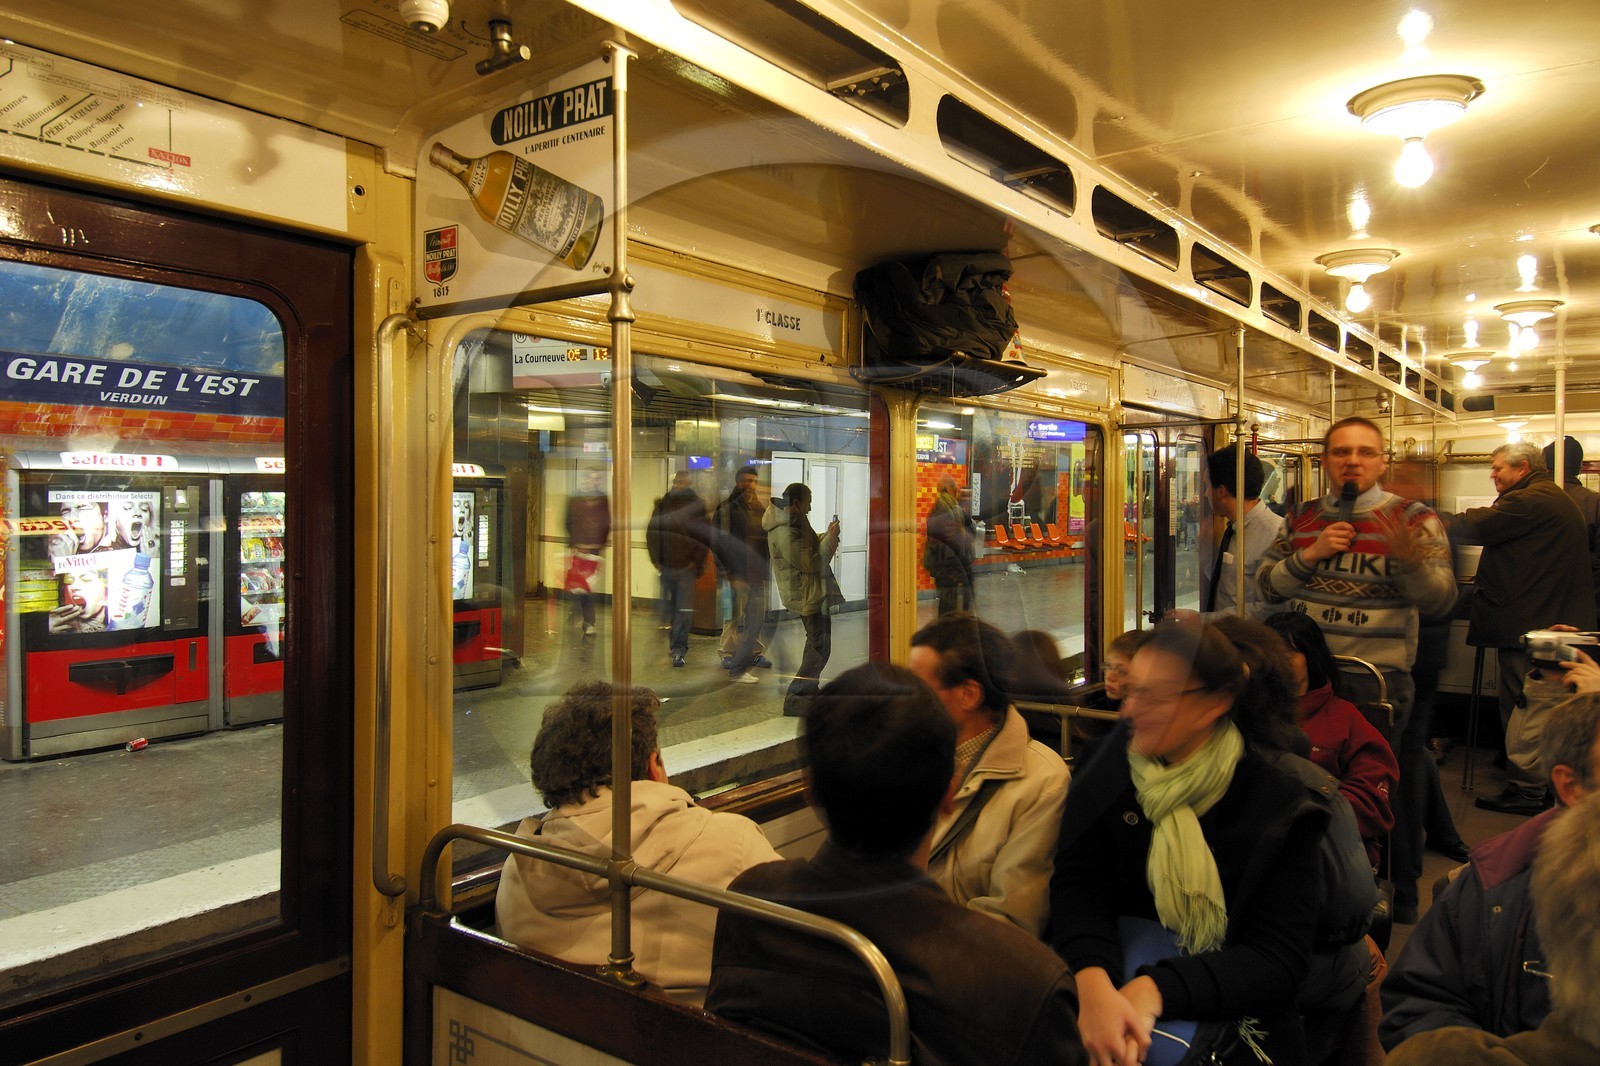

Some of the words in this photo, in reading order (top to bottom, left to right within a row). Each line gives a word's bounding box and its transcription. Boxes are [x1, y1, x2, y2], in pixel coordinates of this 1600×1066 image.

[0, 95, 28, 118] ronnes
[13, 94, 69, 131] Ménilmontant
[503, 96, 556, 142] NOILLY
[563, 80, 607, 125] PRAT
[89, 123, 125, 149] Bagnolet
[562, 125, 606, 145] CENTENAIRE
[442, 249, 456, 258] PRAT
[765, 309, 801, 331] CLASSE
[514, 354, 523, 364] La
[525, 352, 566, 364] Courneuve
[7, 357, 108, 387] GARE
[117, 367, 167, 390] DE
[175, 372, 260, 397] L'EST
[100, 391, 169, 405] VERDUN
[87, 492, 129, 500] distributeur
